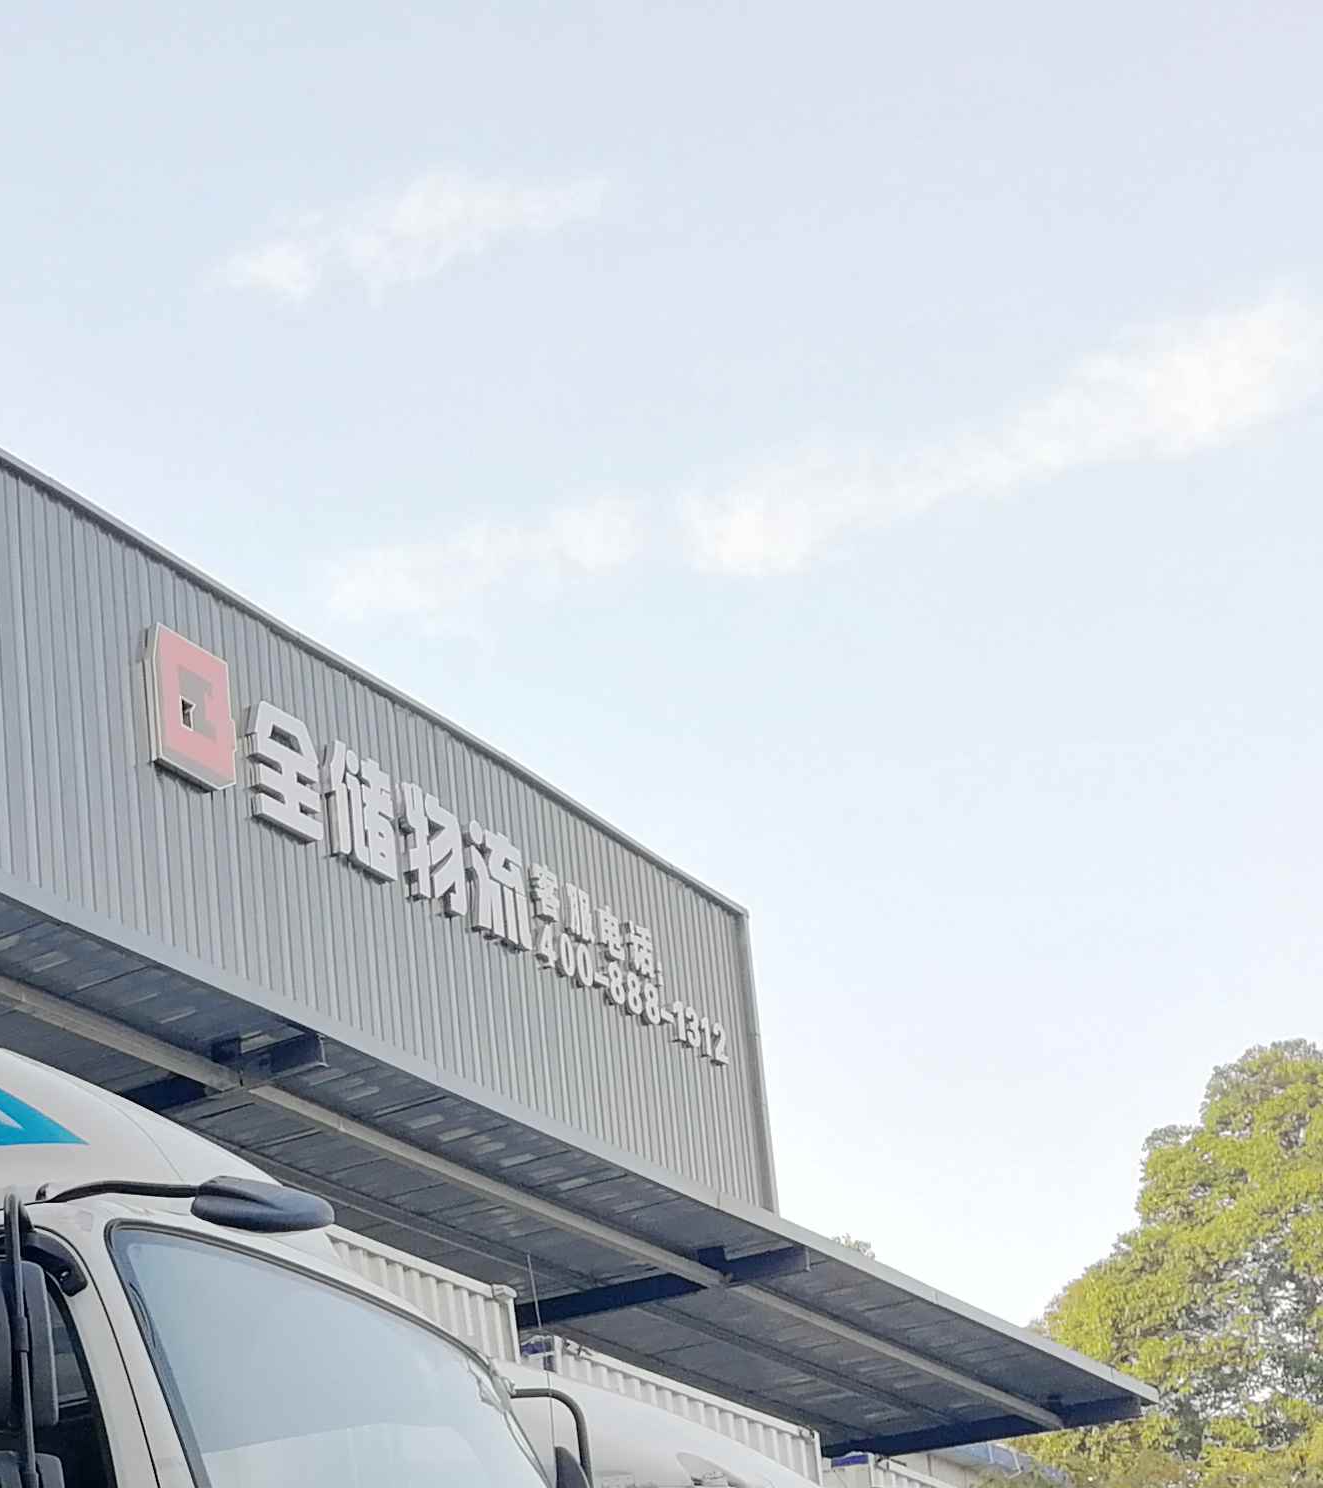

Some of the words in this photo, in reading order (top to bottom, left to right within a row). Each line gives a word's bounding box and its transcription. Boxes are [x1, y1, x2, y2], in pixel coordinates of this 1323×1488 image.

[247, 700, 531, 951] 全储物流
[536, 922, 729, 1066] 400-888-1312
